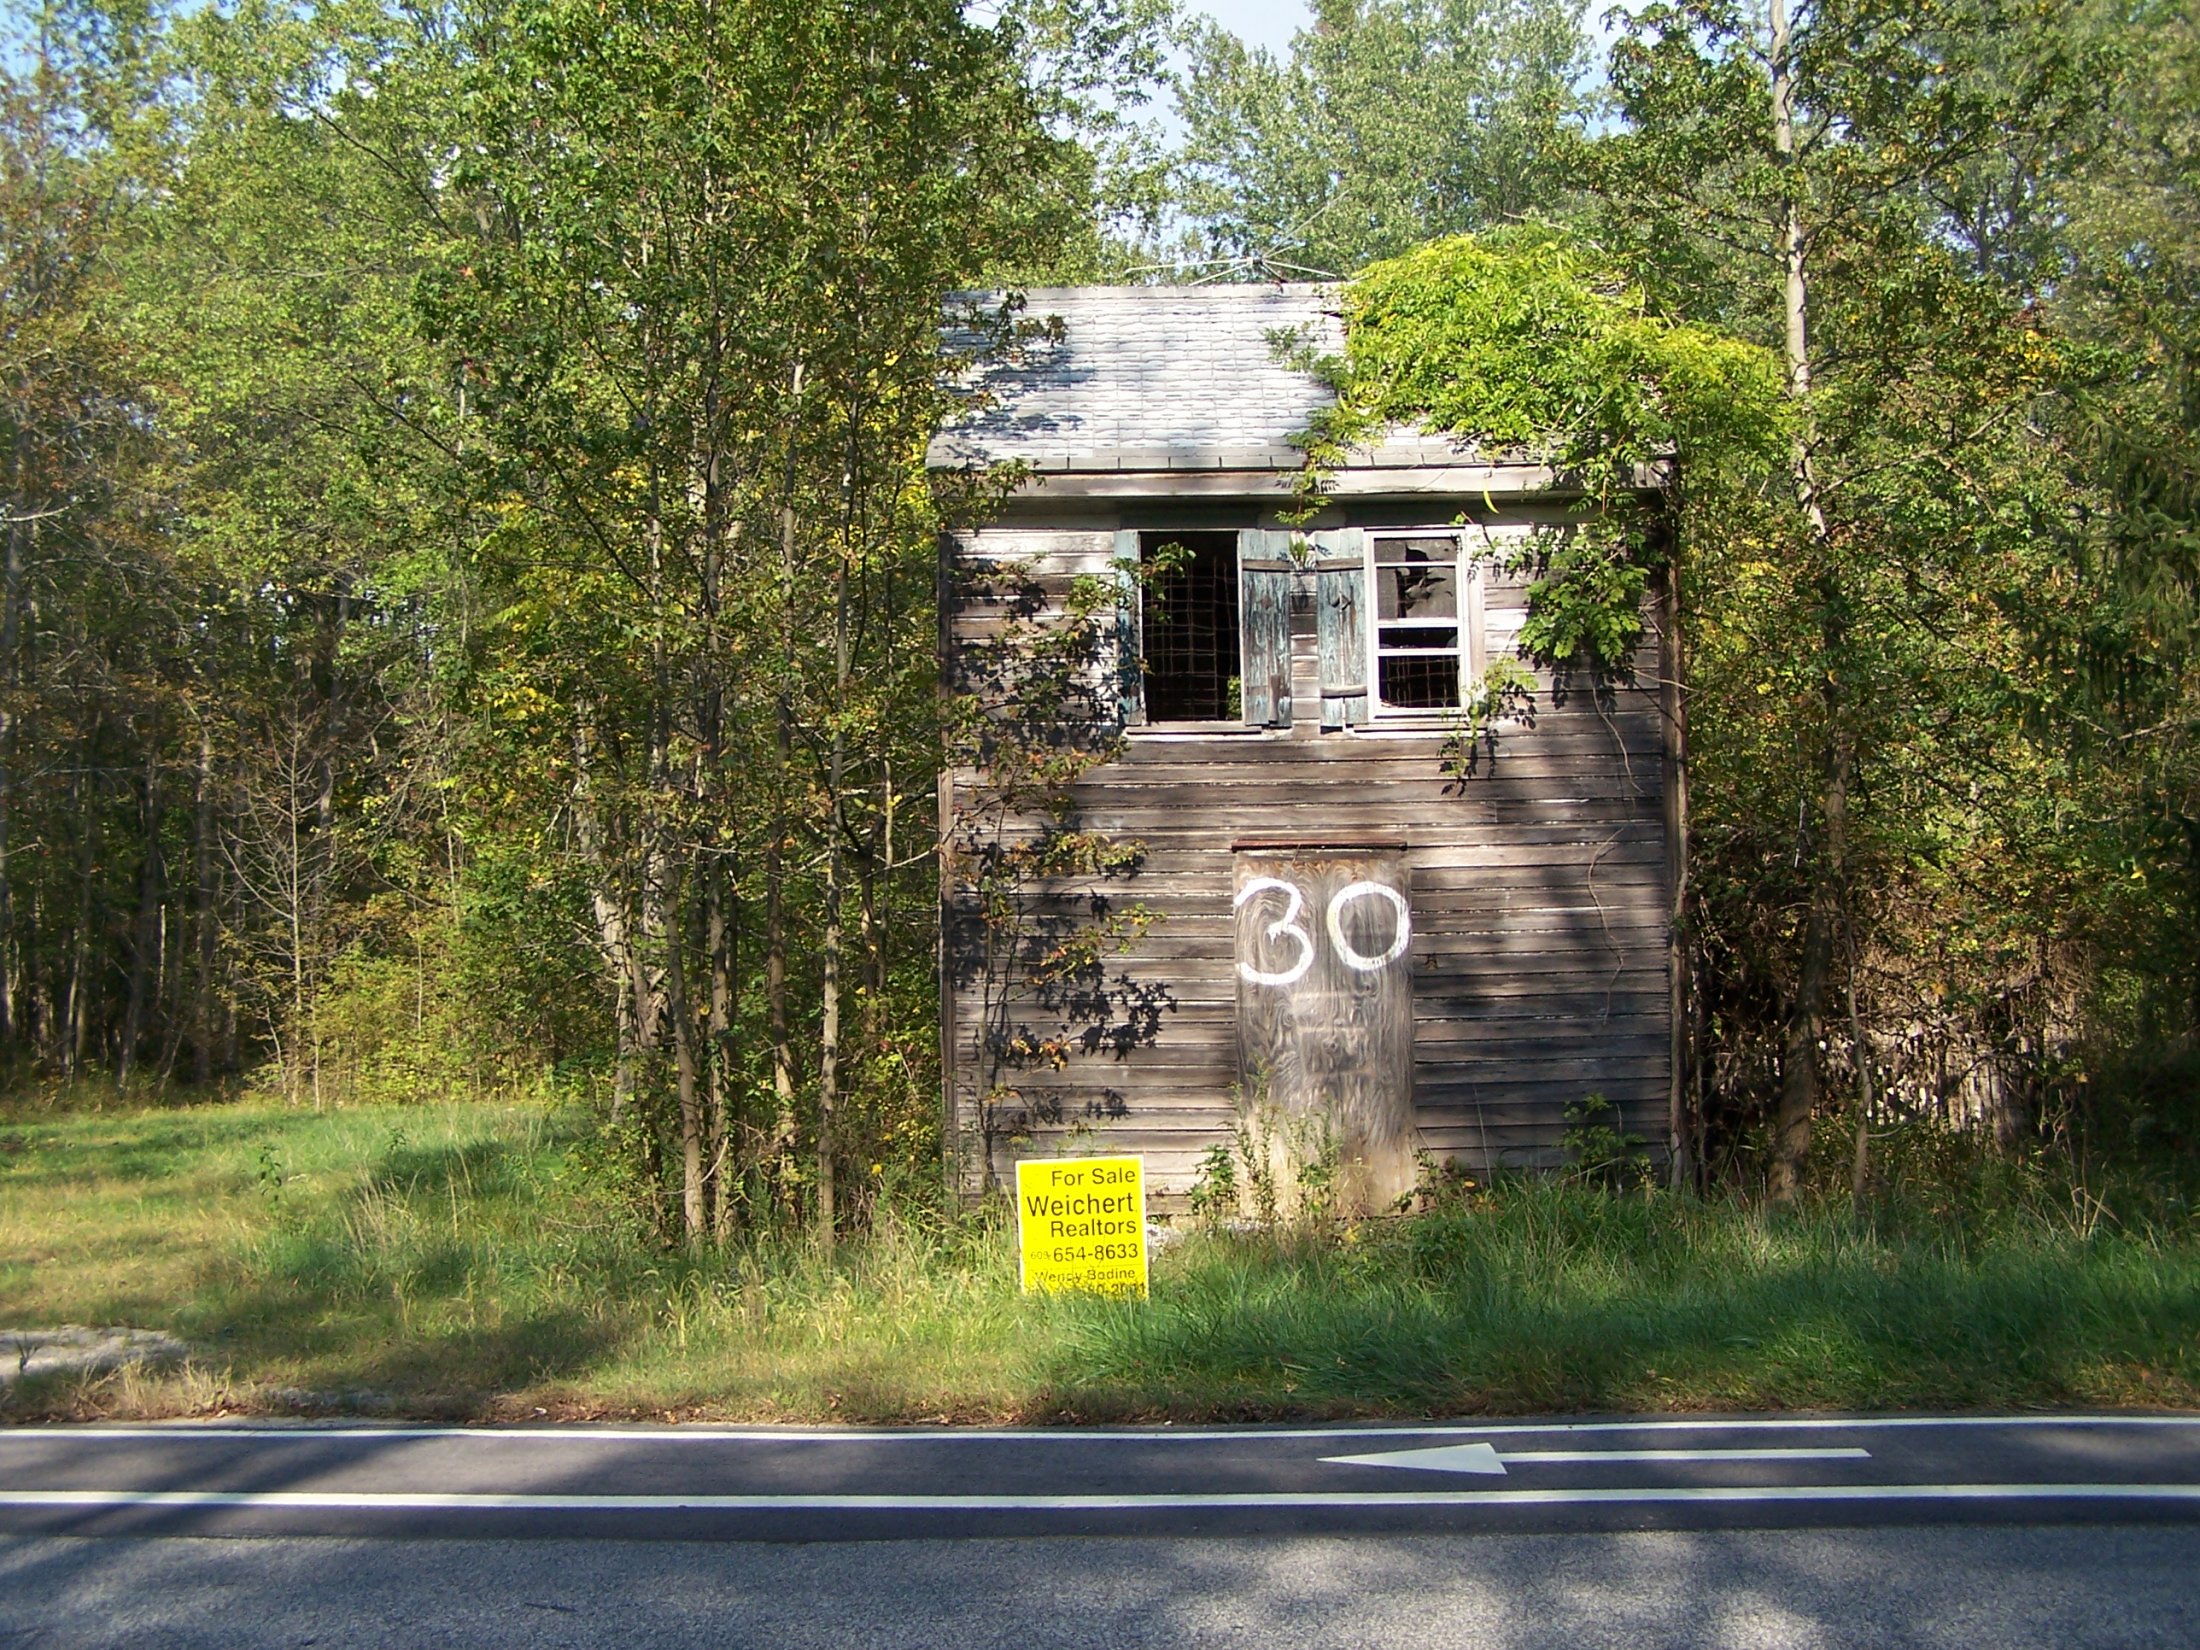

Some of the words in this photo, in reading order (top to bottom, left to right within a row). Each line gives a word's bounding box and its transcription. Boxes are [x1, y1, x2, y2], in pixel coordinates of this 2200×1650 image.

[1233, 876, 1411, 985] 30
[1051, 1170, 1084, 1187] For
[1091, 1167, 1136, 1185] Sale
[1026, 1192, 1134, 1217] Weichert
[1050, 1218, 1137, 1238] Realtors
